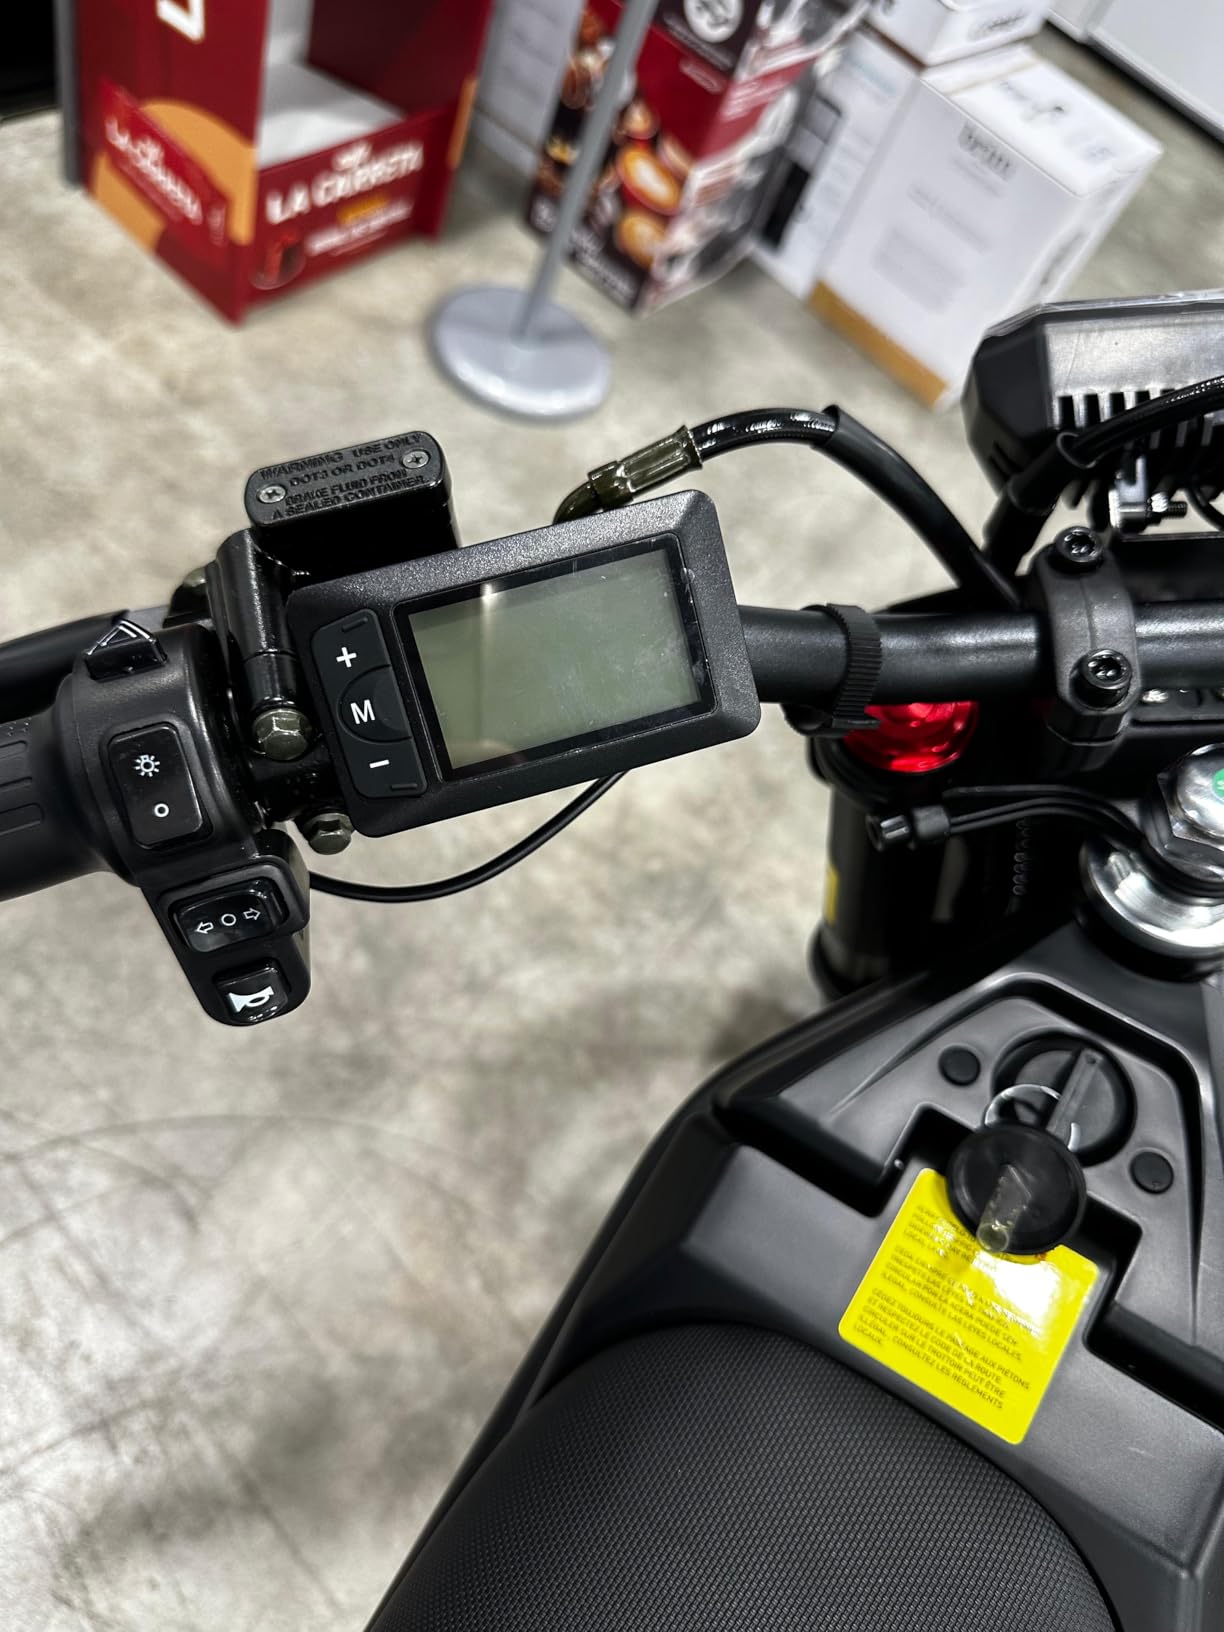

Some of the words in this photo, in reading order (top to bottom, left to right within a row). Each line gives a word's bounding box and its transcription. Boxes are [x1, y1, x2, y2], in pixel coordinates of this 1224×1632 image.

[260, 451, 344, 480] WARNING
[352, 443, 382, 458] USE
[383, 433, 421, 450] ONLY
[288, 469, 328, 487] DOT3
[330, 463, 354, 477] OR
[355, 453, 395, 471] DOT4
[284, 487, 329, 506] BRAKE
[329, 477, 368, 495] FLUID
[368, 468, 407, 485] FROM
[271, 508, 284, 519] A
[284, 494, 340, 516] SEALED
[350, 700, 376, 724] M
